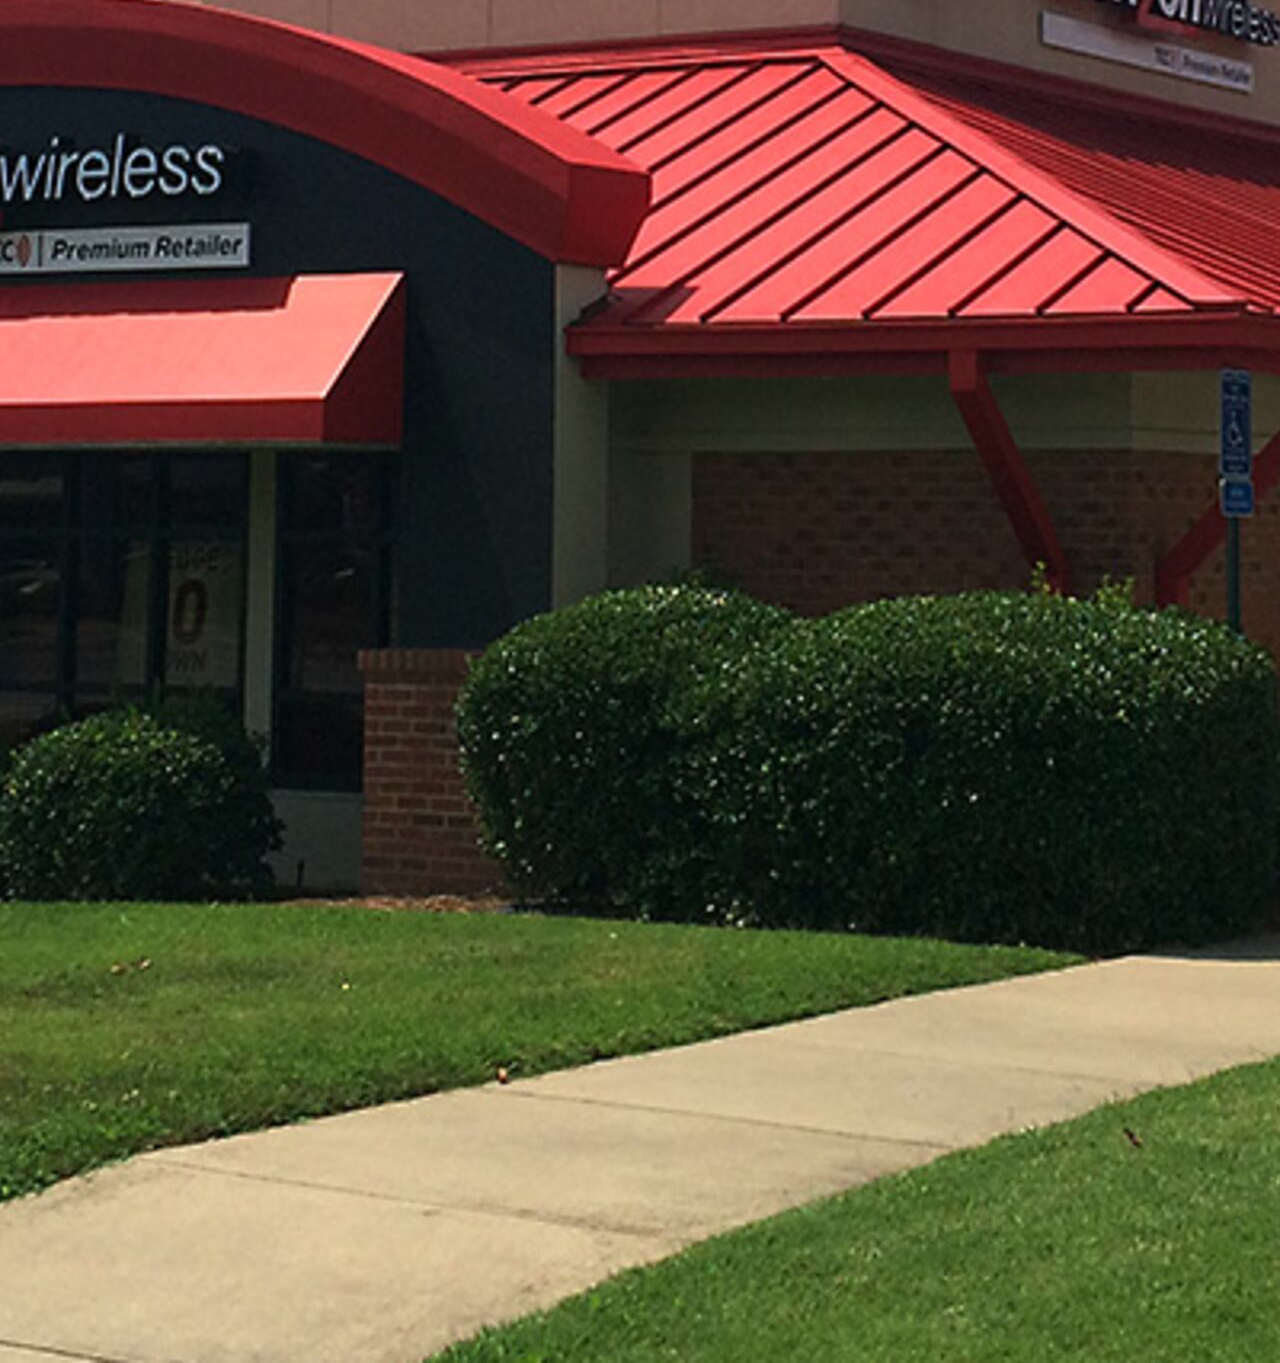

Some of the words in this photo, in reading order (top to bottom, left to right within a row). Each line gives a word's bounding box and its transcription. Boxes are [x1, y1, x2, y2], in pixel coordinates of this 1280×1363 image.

[0, 133, 224, 202] wireless
[51, 239, 150, 261] Premium
[154, 235, 243, 258] Retailer
